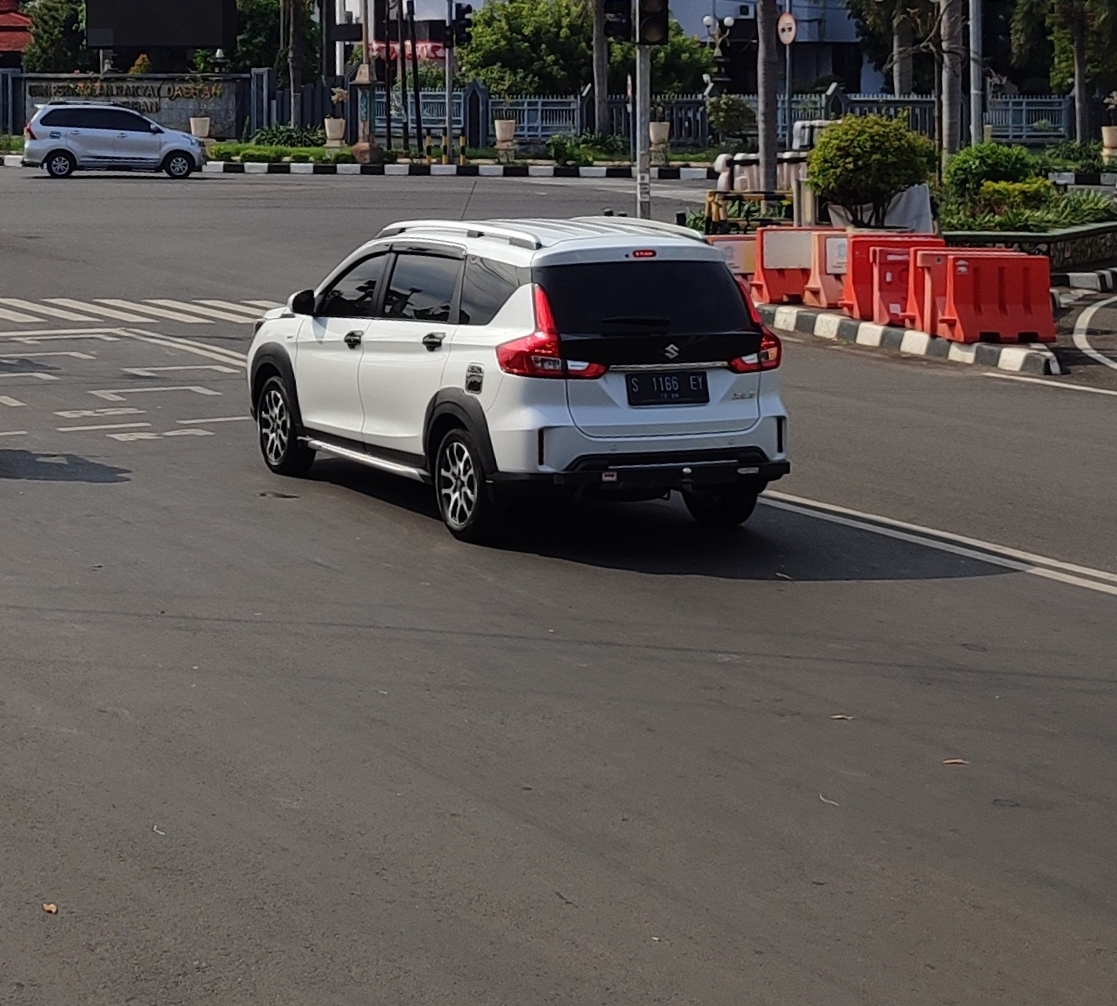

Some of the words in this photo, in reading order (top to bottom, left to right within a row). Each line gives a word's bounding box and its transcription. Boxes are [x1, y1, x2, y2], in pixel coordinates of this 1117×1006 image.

[631, 377, 639, 392] S
[652, 376, 679, 392] 1186
[689, 375, 703, 390] EY
